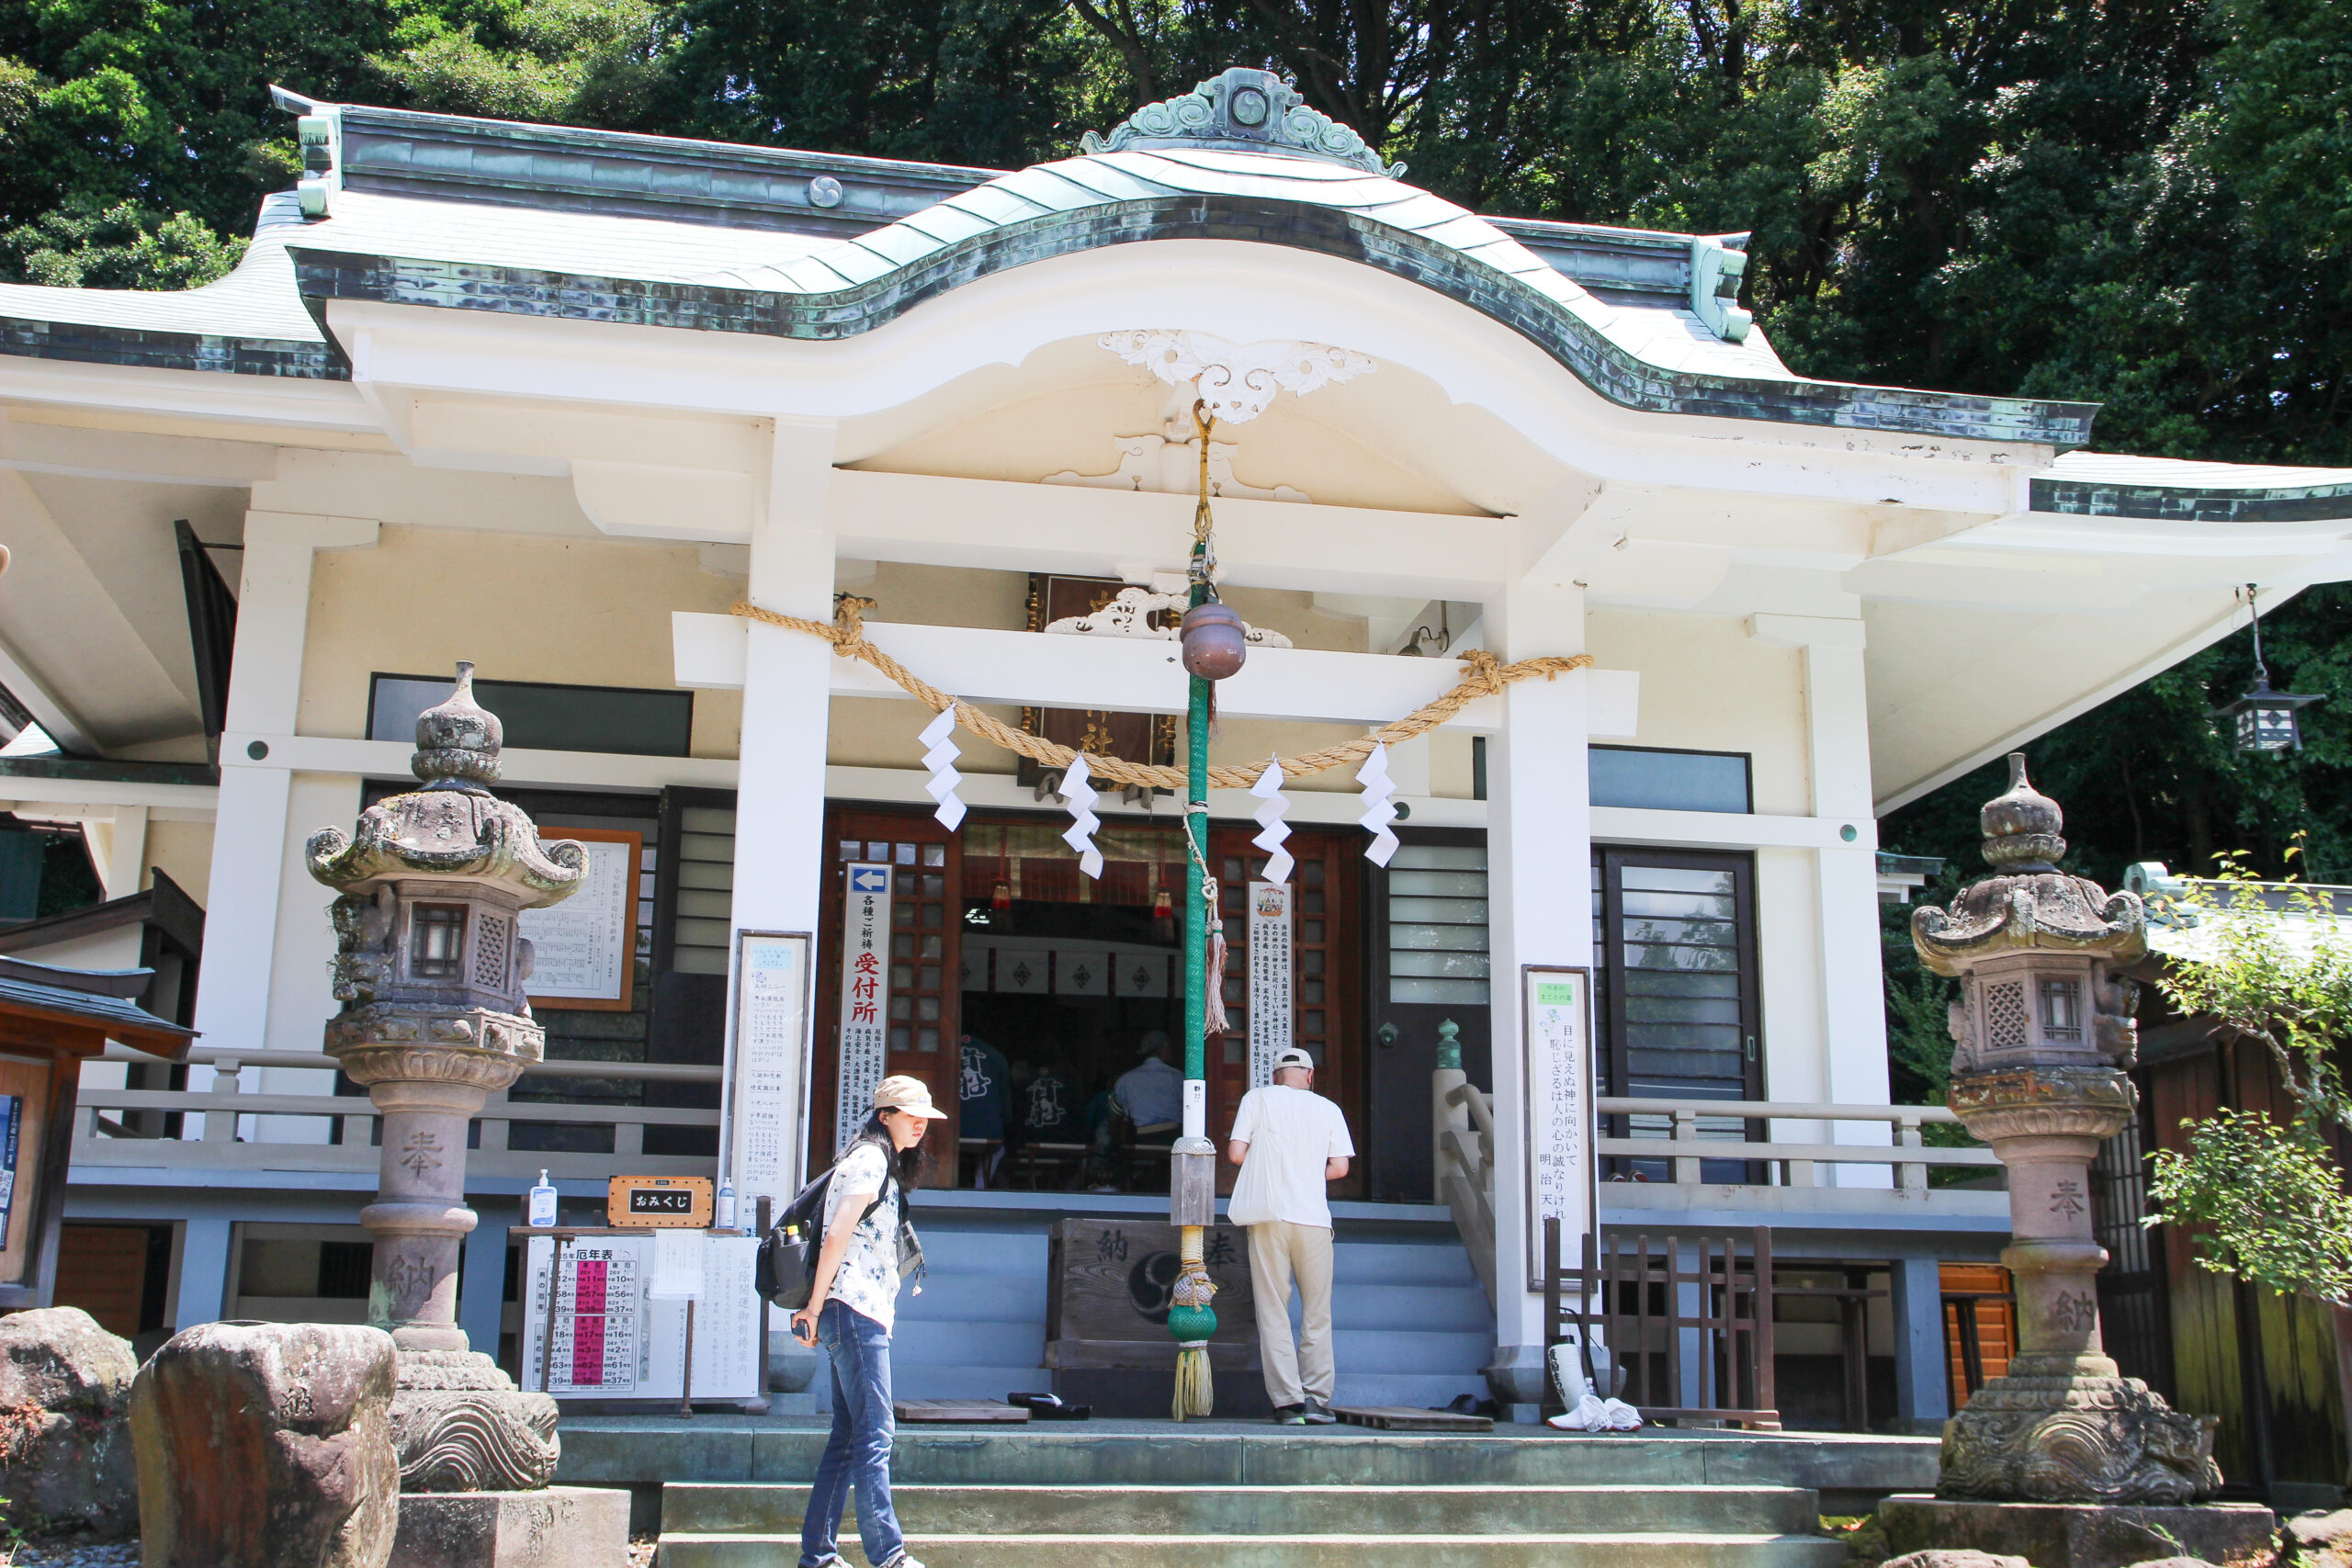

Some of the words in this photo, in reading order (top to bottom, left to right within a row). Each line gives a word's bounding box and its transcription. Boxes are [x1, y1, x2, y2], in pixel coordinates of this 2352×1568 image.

[862, 895, 874, 949] 各種ご祈祷
[851, 952, 879, 1024] 受付所
[1563, 1024, 1578, 1166] 目に見えぬ神に向かいて
[1549, 1039, 1566, 1220] 恥じざるは人の心の誠なりけれ
[636, 1194, 687, 1208] おみくじ
[576, 1249, 613, 1260] 厄年表
